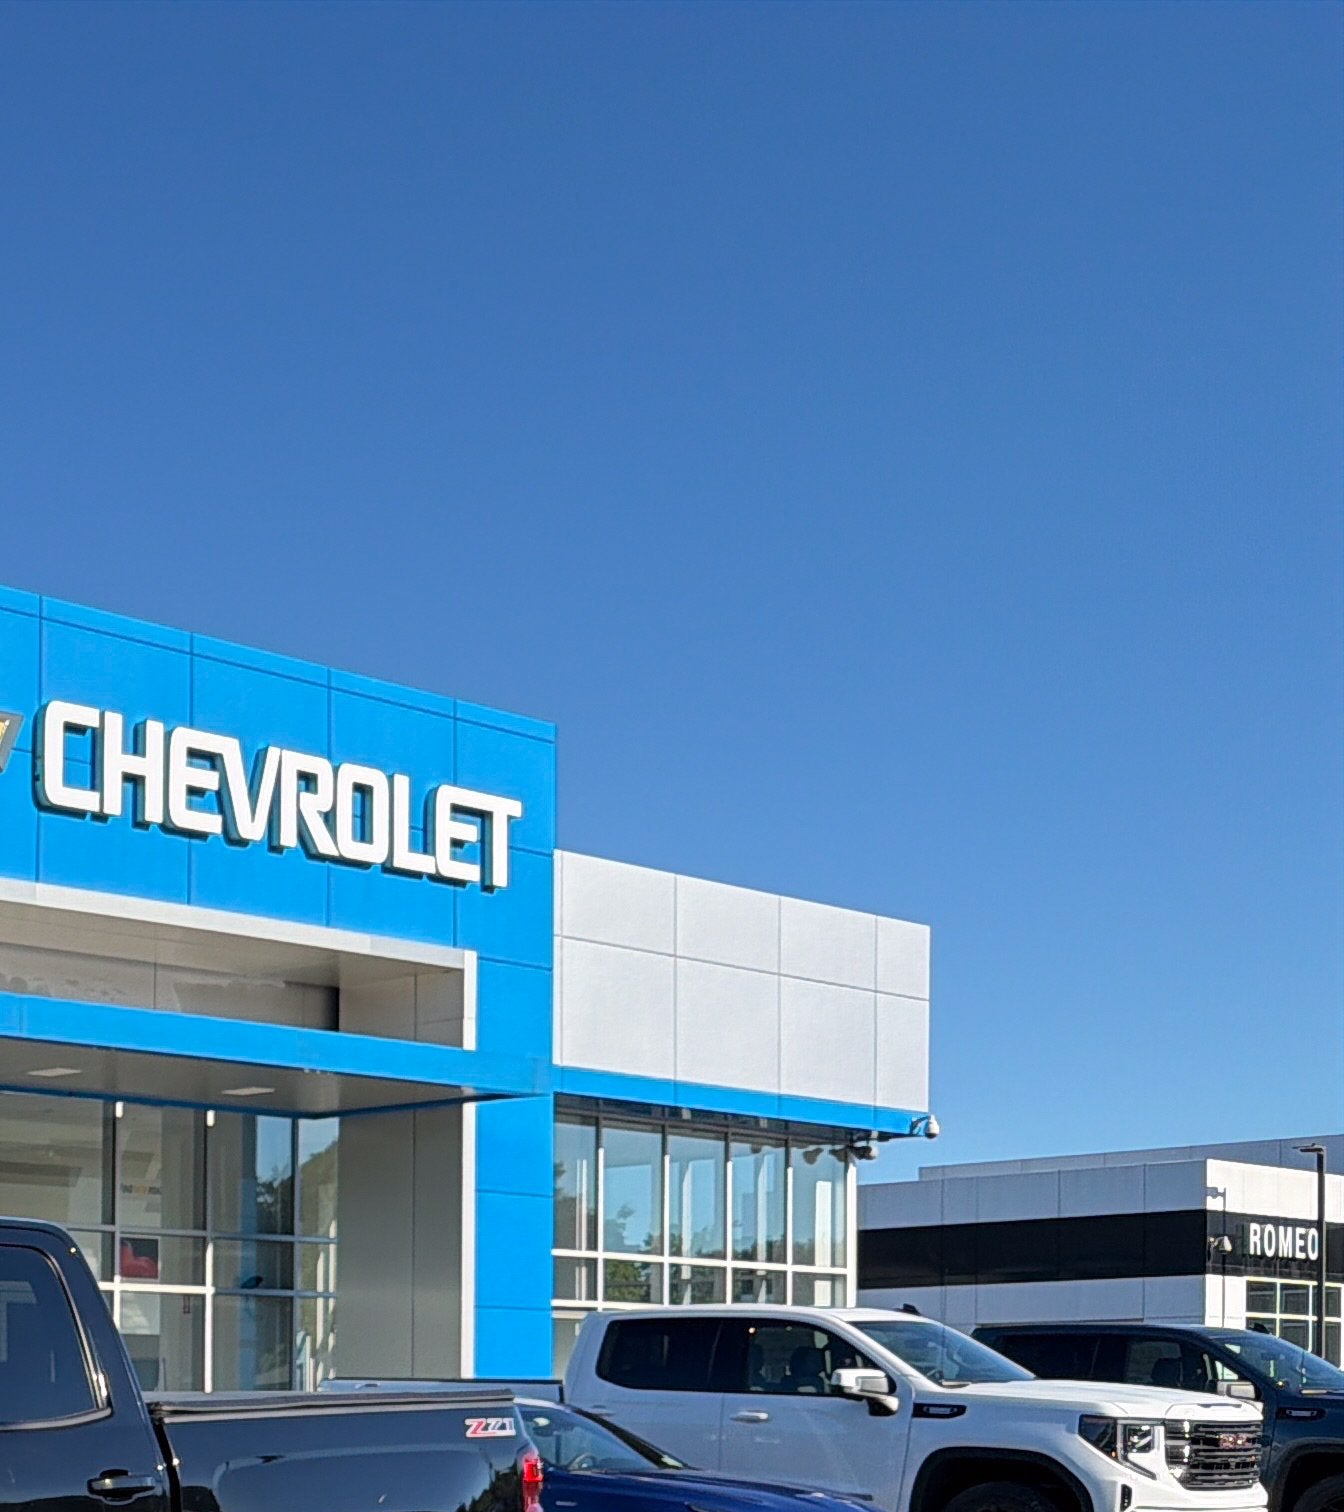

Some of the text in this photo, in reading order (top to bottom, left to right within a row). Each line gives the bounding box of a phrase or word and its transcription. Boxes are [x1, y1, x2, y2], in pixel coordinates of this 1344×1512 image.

[33, 700, 523, 892] CHEVROLET
[1249, 1222, 1319, 1261] ROMEO
[464, 1417, 516, 1438] Z71
